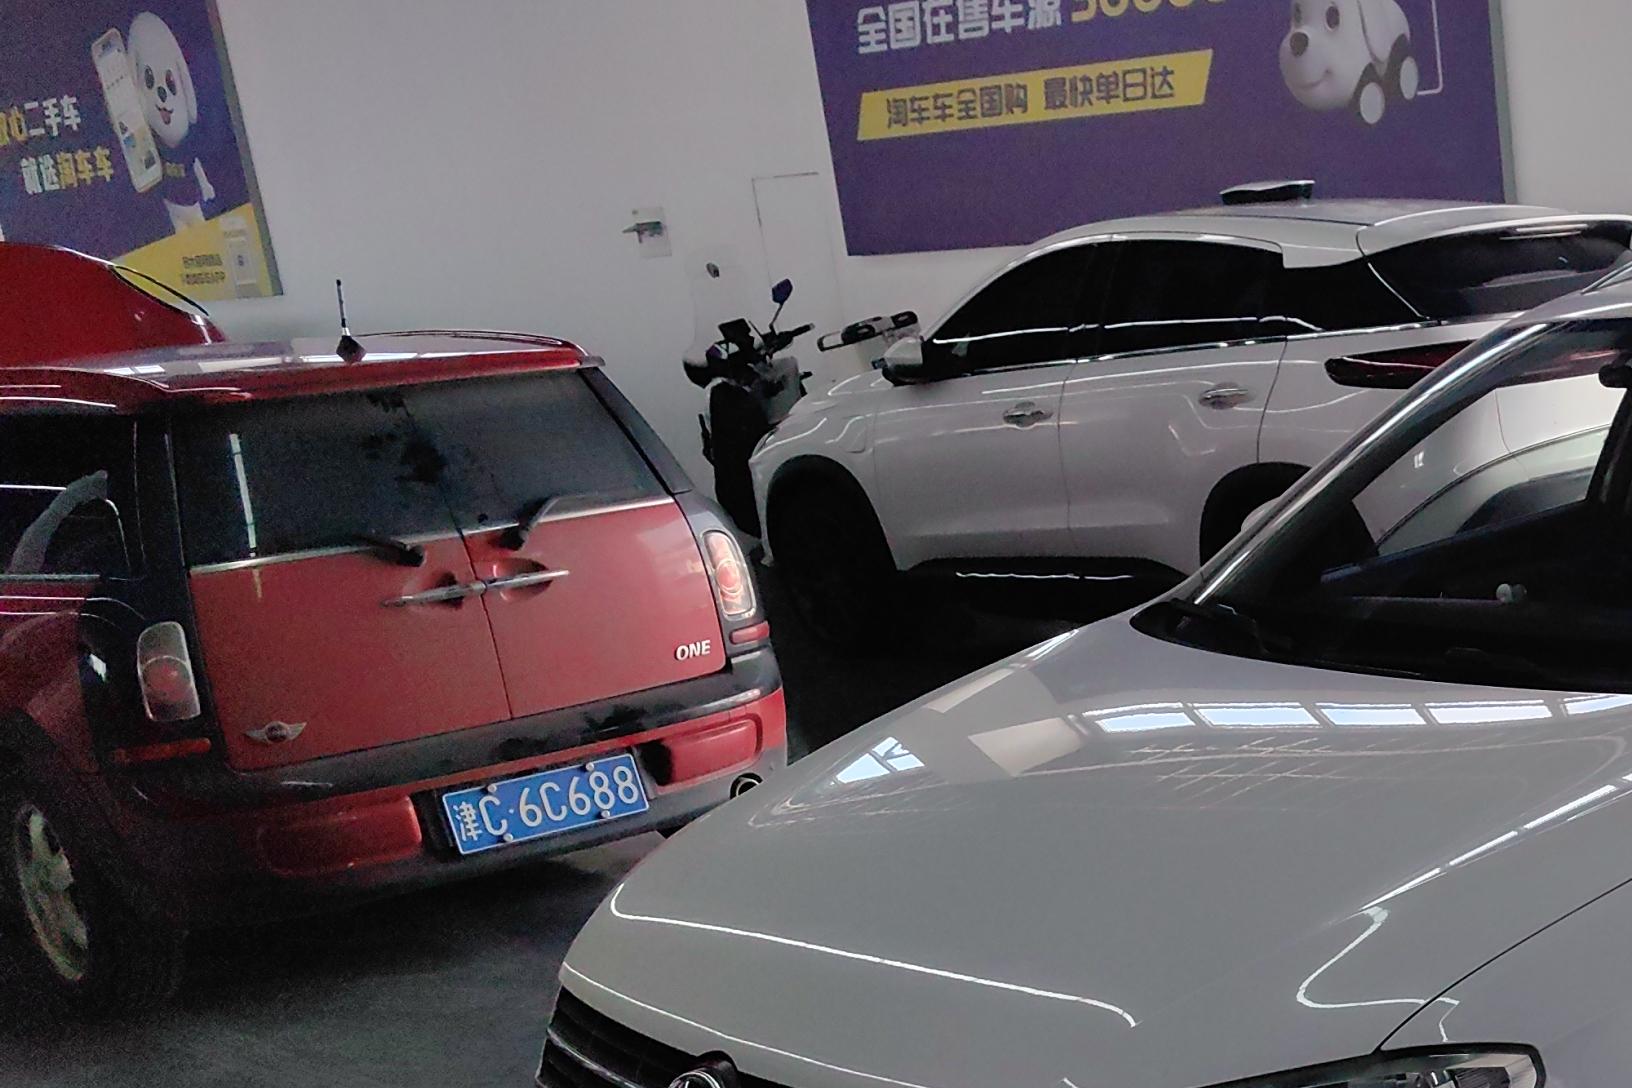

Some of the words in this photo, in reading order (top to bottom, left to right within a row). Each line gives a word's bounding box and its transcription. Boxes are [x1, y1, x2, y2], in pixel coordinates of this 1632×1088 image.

[858, 0, 1061, 54] 全国在售车源
[886, 82, 1028, 128] 淘车车全国购
[1044, 65, 1175, 112] 最快单日达
[676, 640, 711, 661] ONE
